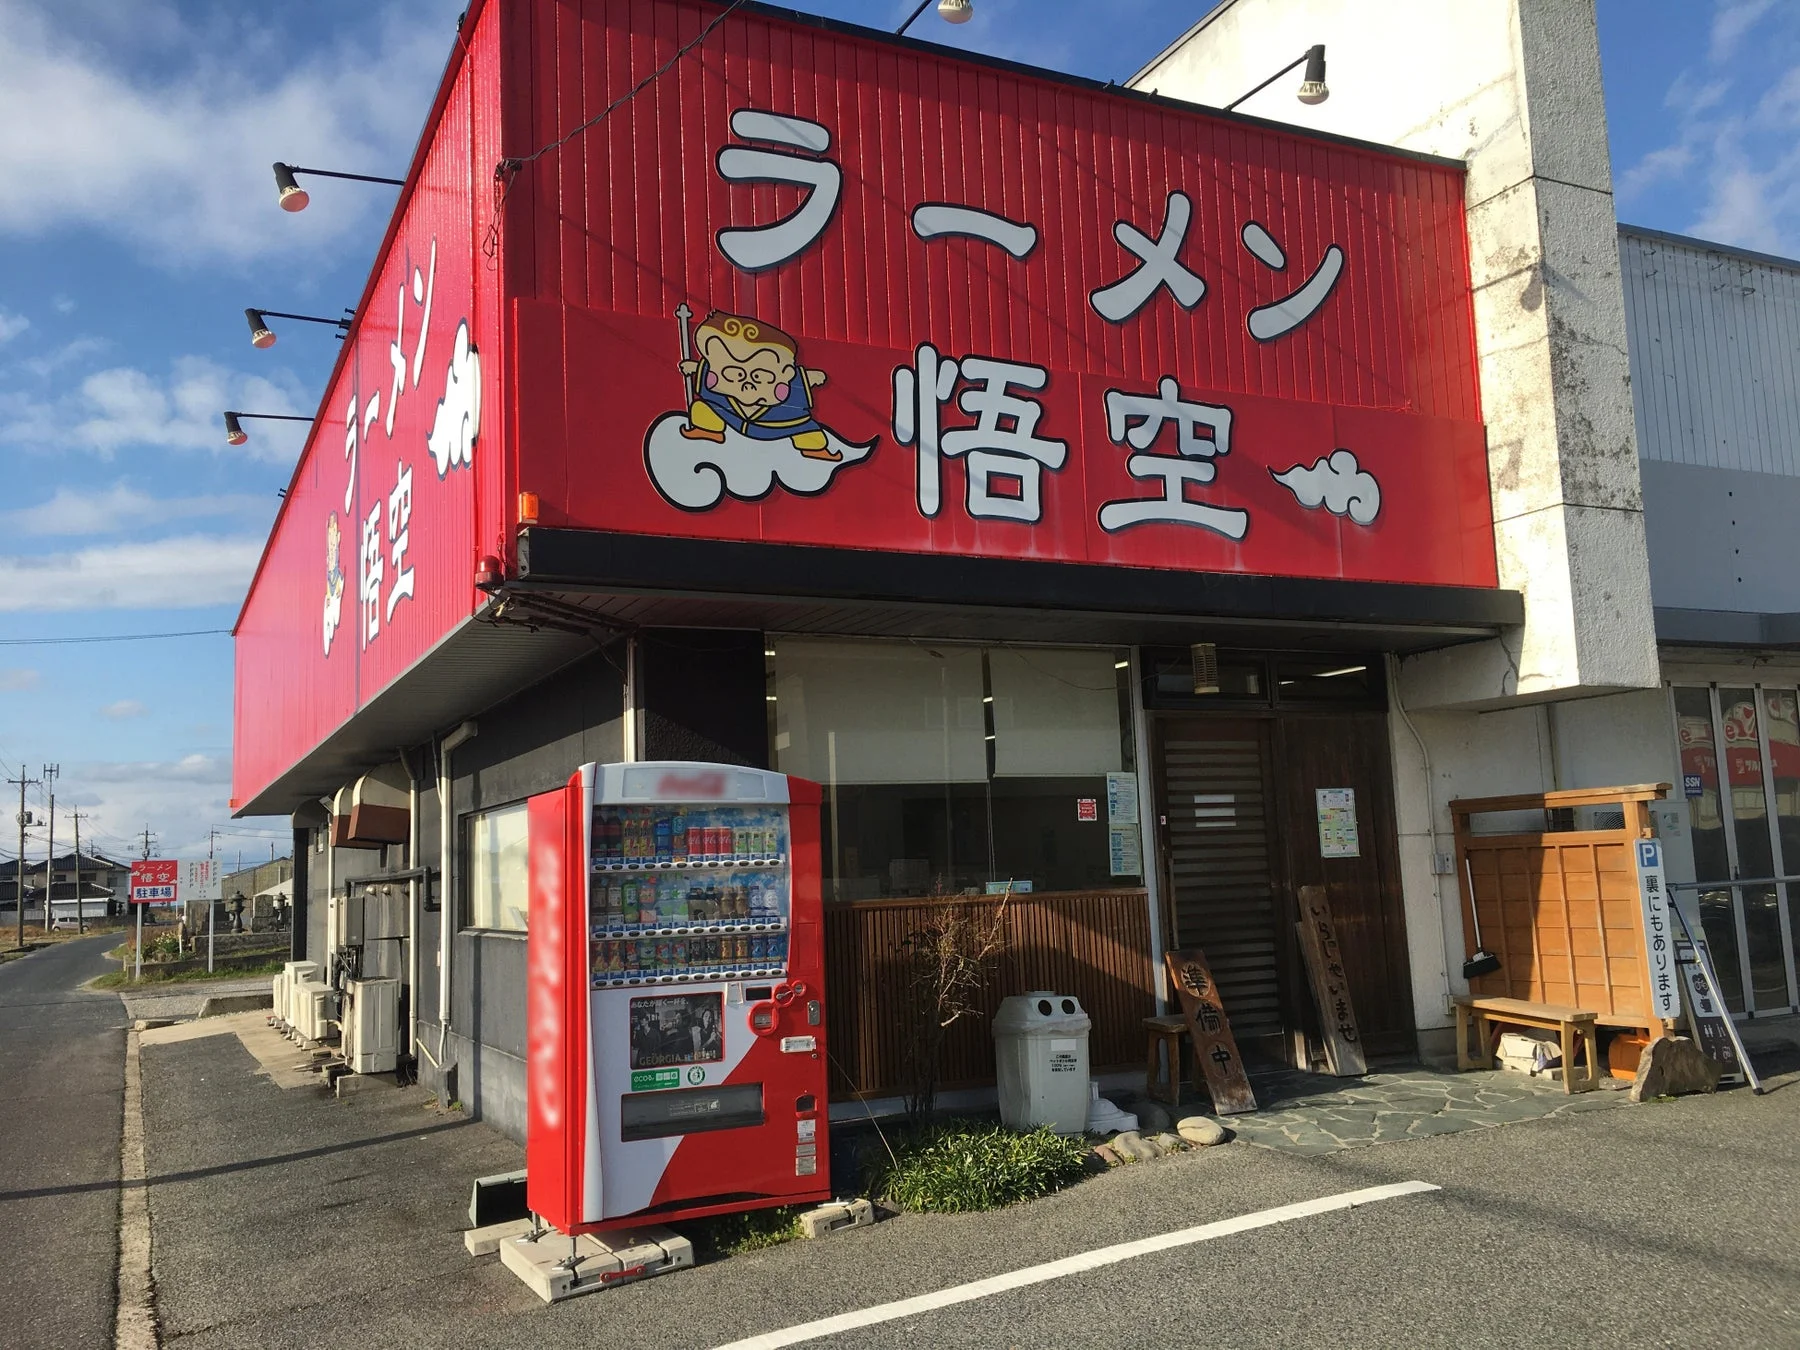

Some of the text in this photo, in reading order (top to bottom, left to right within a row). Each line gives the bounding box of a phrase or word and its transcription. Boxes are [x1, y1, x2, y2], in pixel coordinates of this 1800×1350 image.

[716, 108, 1345, 344] ラーメン
[344, 235, 436, 516] ラーメン
[890, 341, 1250, 542] 悟空
[360, 459, 416, 653] 悟空
[1684, 776, 1701, 788] SSN
[136, 886, 172, 898] 駐車場
[139, 863, 172, 872] ラーメン
[140, 872, 170, 883] 悟空
[1645, 874, 1673, 1011] 裏にもあります
[640, 1053, 682, 1066] GEORGIA
[1181, 963, 1232, 1076] 準備中
